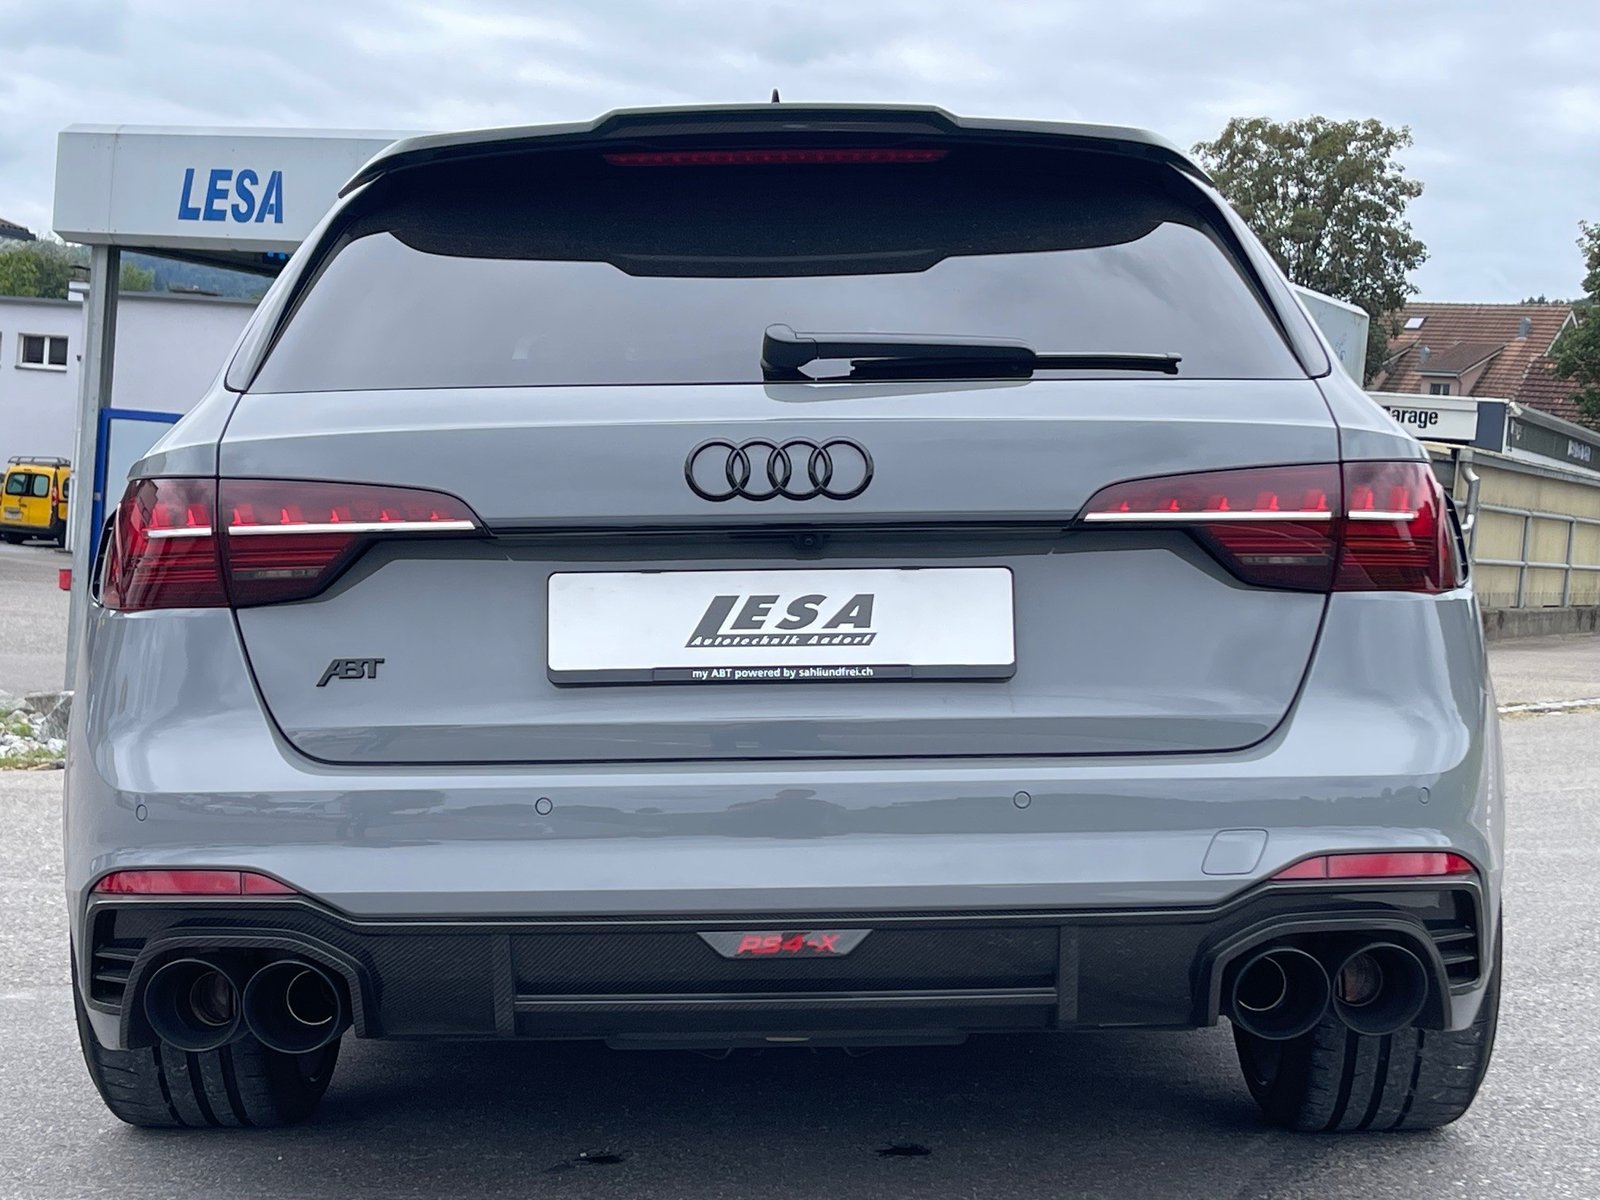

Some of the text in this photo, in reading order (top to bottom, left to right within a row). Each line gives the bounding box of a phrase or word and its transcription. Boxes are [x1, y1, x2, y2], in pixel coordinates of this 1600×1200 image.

[177, 168, 284, 224] LESA
[1381, 405, 1439, 429] arage
[686, 594, 875, 638] LESA
[690, 634, 872, 646] Autotechnik Aadorf
[316, 658, 385, 687] ABT
[692, 666, 874, 681] my ABT powered by sahliundfrei.ch
[736, 933, 841, 954] RS4-X
